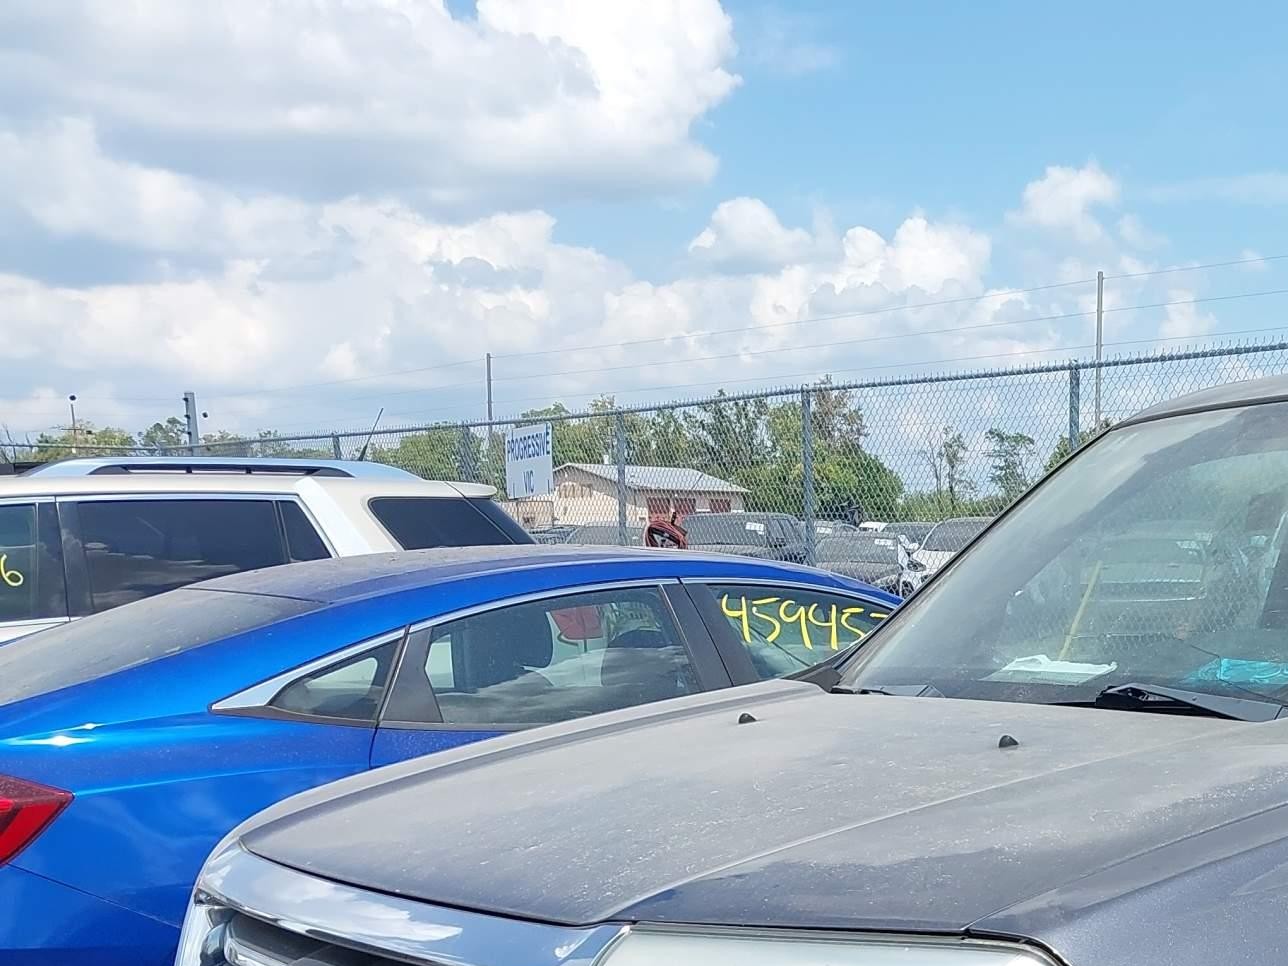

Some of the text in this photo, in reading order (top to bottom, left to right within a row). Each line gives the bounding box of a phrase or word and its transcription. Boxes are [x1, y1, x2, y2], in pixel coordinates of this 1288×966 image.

[507, 429, 550, 461] PROGRESSIVE
[523, 470, 535, 493] VIC
[721, 594, 888, 650] 45945
